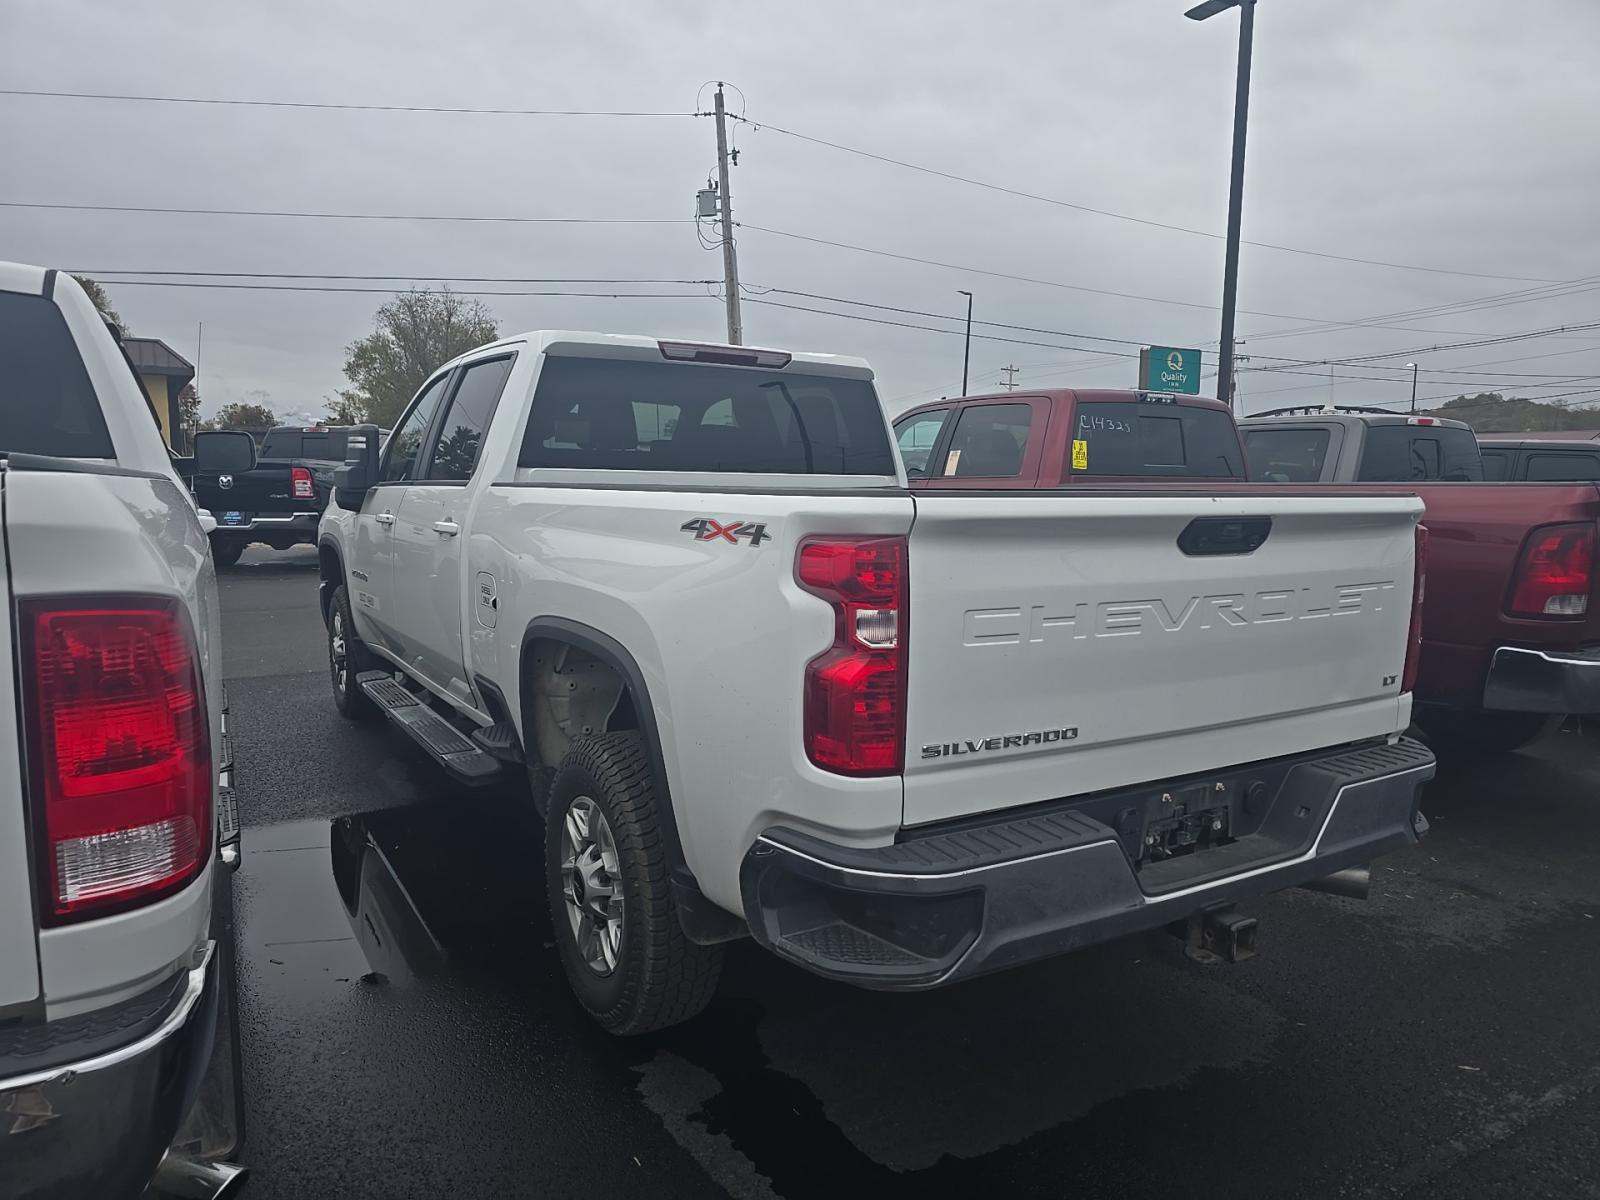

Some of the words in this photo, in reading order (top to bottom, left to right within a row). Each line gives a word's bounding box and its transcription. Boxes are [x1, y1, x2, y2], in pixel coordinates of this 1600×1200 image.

[1167, 351, 1183, 370] Q
[1160, 371, 1187, 384] Quality
[963, 580, 1395, 647] CHEVROLET
[1382, 674, 1399, 687] LT
[921, 727, 1078, 760] SILVERADO
